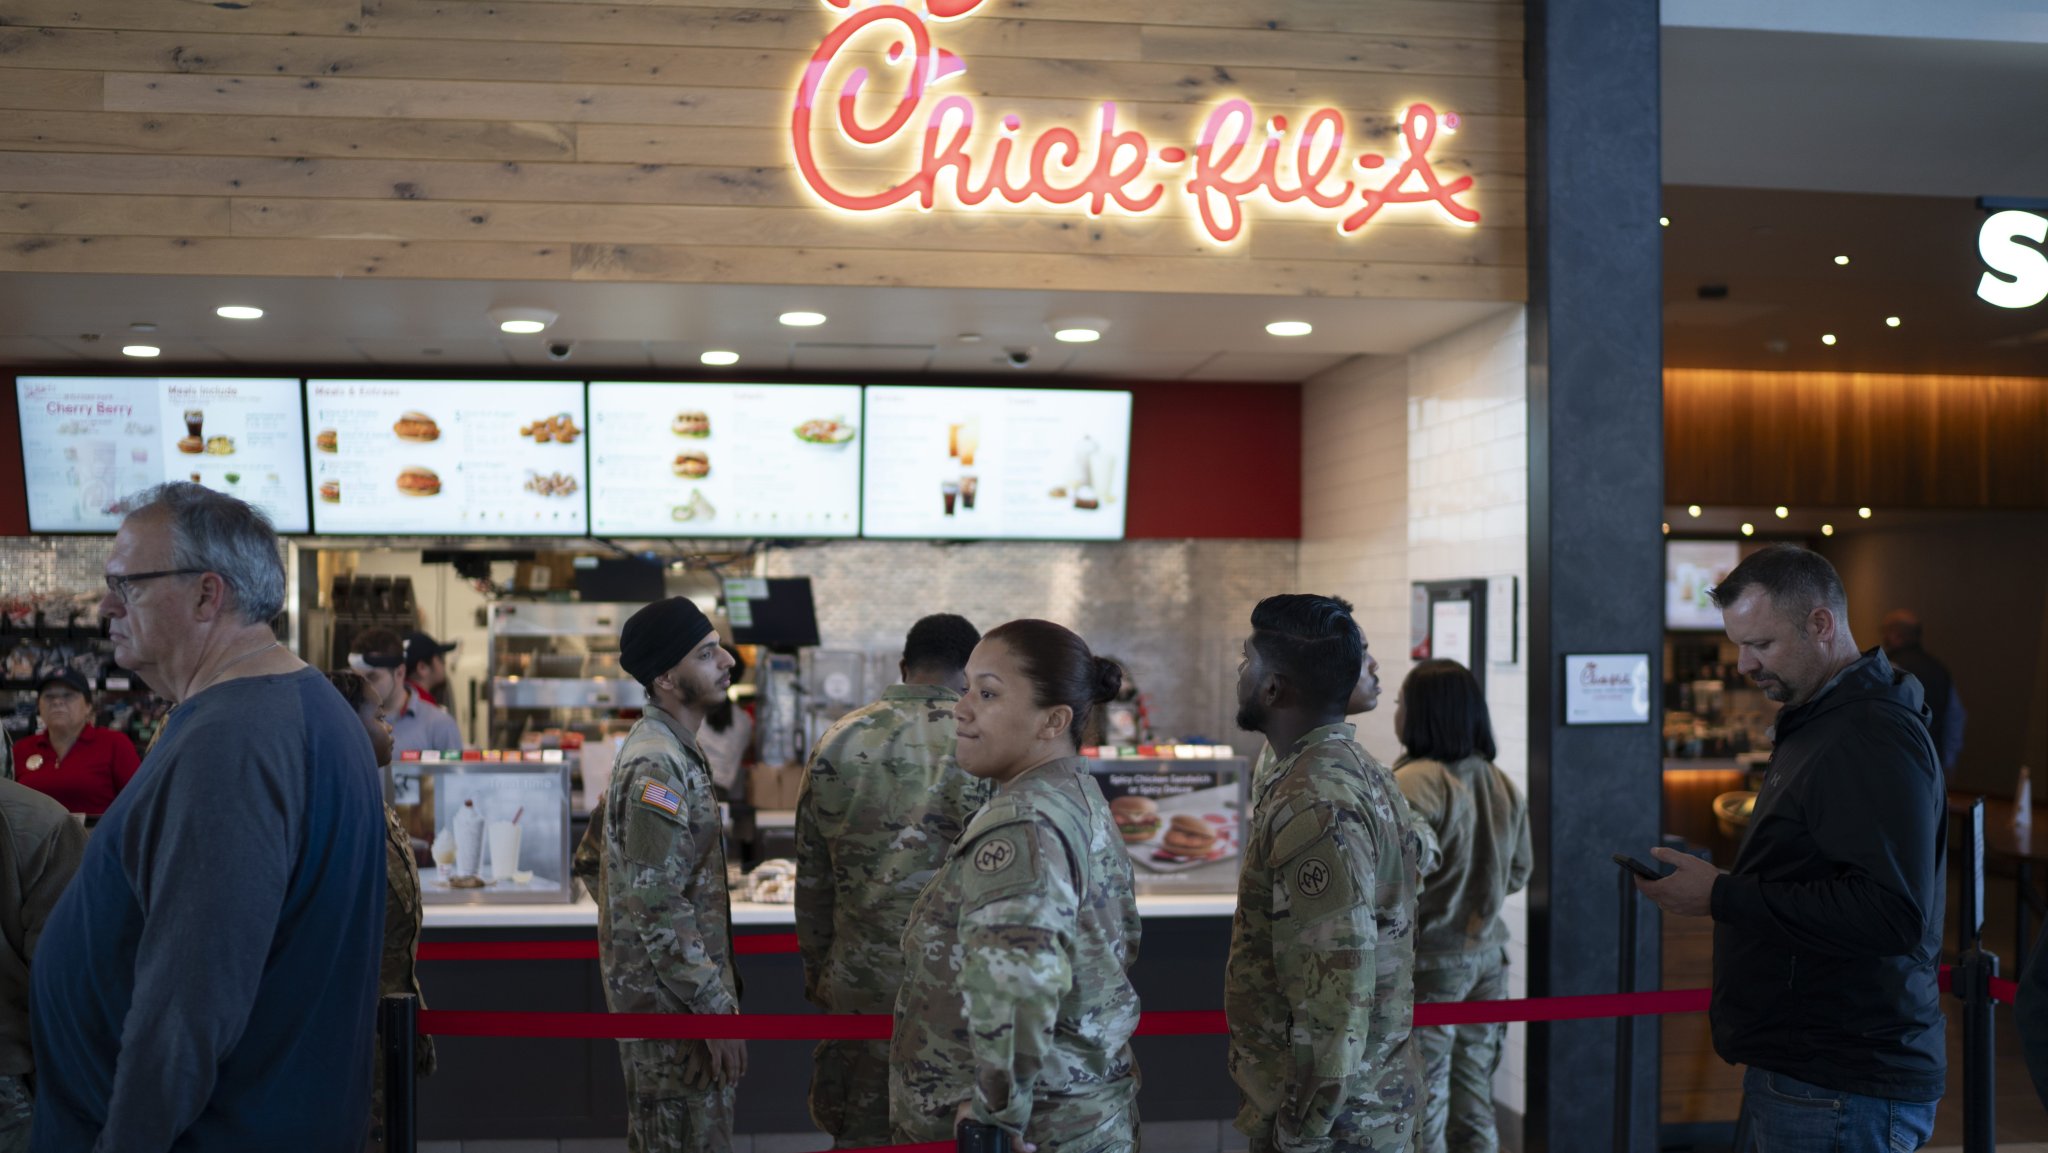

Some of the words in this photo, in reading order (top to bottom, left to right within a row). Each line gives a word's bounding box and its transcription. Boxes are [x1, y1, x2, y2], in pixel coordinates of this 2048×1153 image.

[46, 401, 93, 416] Cherry
[96, 402, 132, 416] Berry
[1109, 774, 1132, 785] Spicy
[1134, 774, 1169, 784] Chicken
[1170, 774, 1211, 784] Sandwich
[1140, 785, 1161, 795] Spicy
